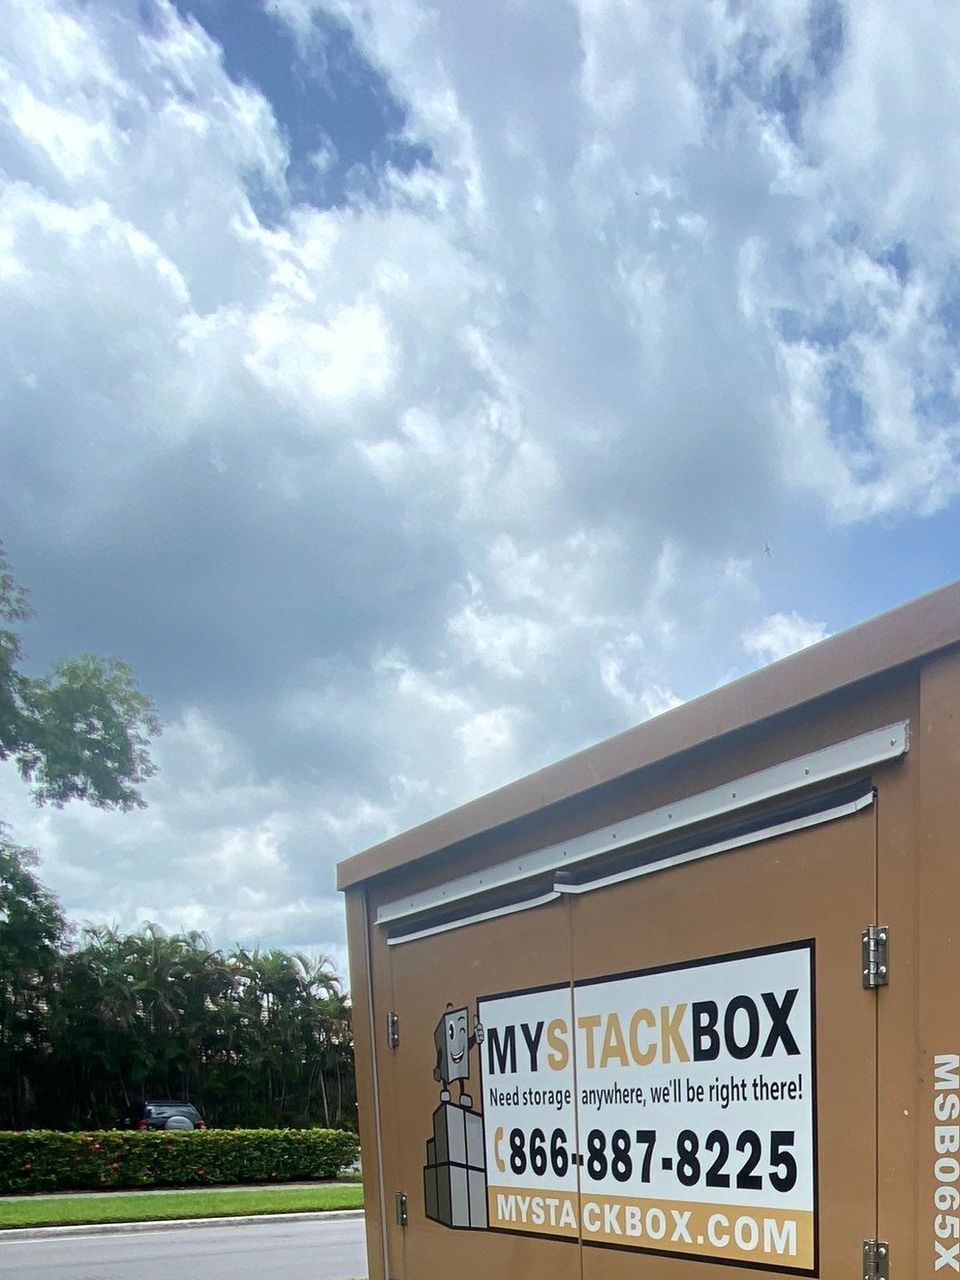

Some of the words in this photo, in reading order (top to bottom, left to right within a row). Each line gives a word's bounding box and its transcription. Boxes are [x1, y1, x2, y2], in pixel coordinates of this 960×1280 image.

[487, 989, 801, 1075] MYSTACKBOX
[489, 1086, 519, 1107] Need
[523, 1087, 571, 1110] storage
[582, 1082, 646, 1111] anywhere,
[650, 1079, 681, 1103] we'll
[686, 1078, 704, 1102] be
[709, 1076, 747, 1109] right
[752, 1073, 802, 1100] there!
[509, 1127, 798, 1192] 866-887-8225
[934, 1053, 960, 1273] MSB065X
[497, 1193, 798, 1256] MYSTACKBOX.COM
